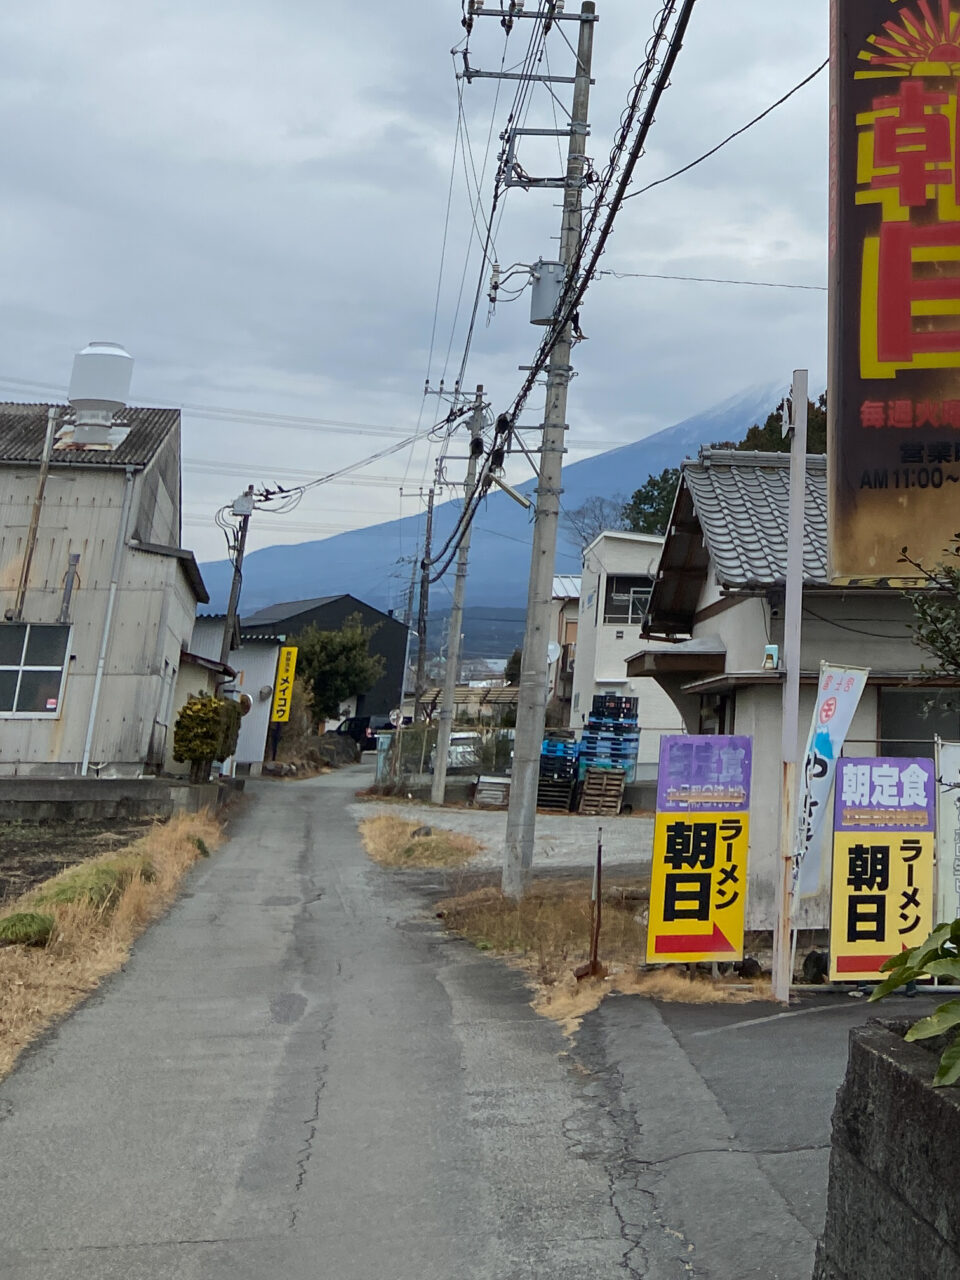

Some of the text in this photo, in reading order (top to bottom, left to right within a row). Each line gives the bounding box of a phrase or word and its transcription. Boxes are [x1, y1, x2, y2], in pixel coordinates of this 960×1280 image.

[277, 677, 290, 718] メイコウ
[841, 763, 929, 807] 朝定食
[663, 821, 716, 922] 朝日
[714, 818, 743, 911] ラーメン
[846, 843, 891, 943] 朝日
[896, 838, 923, 935] ラーメン
